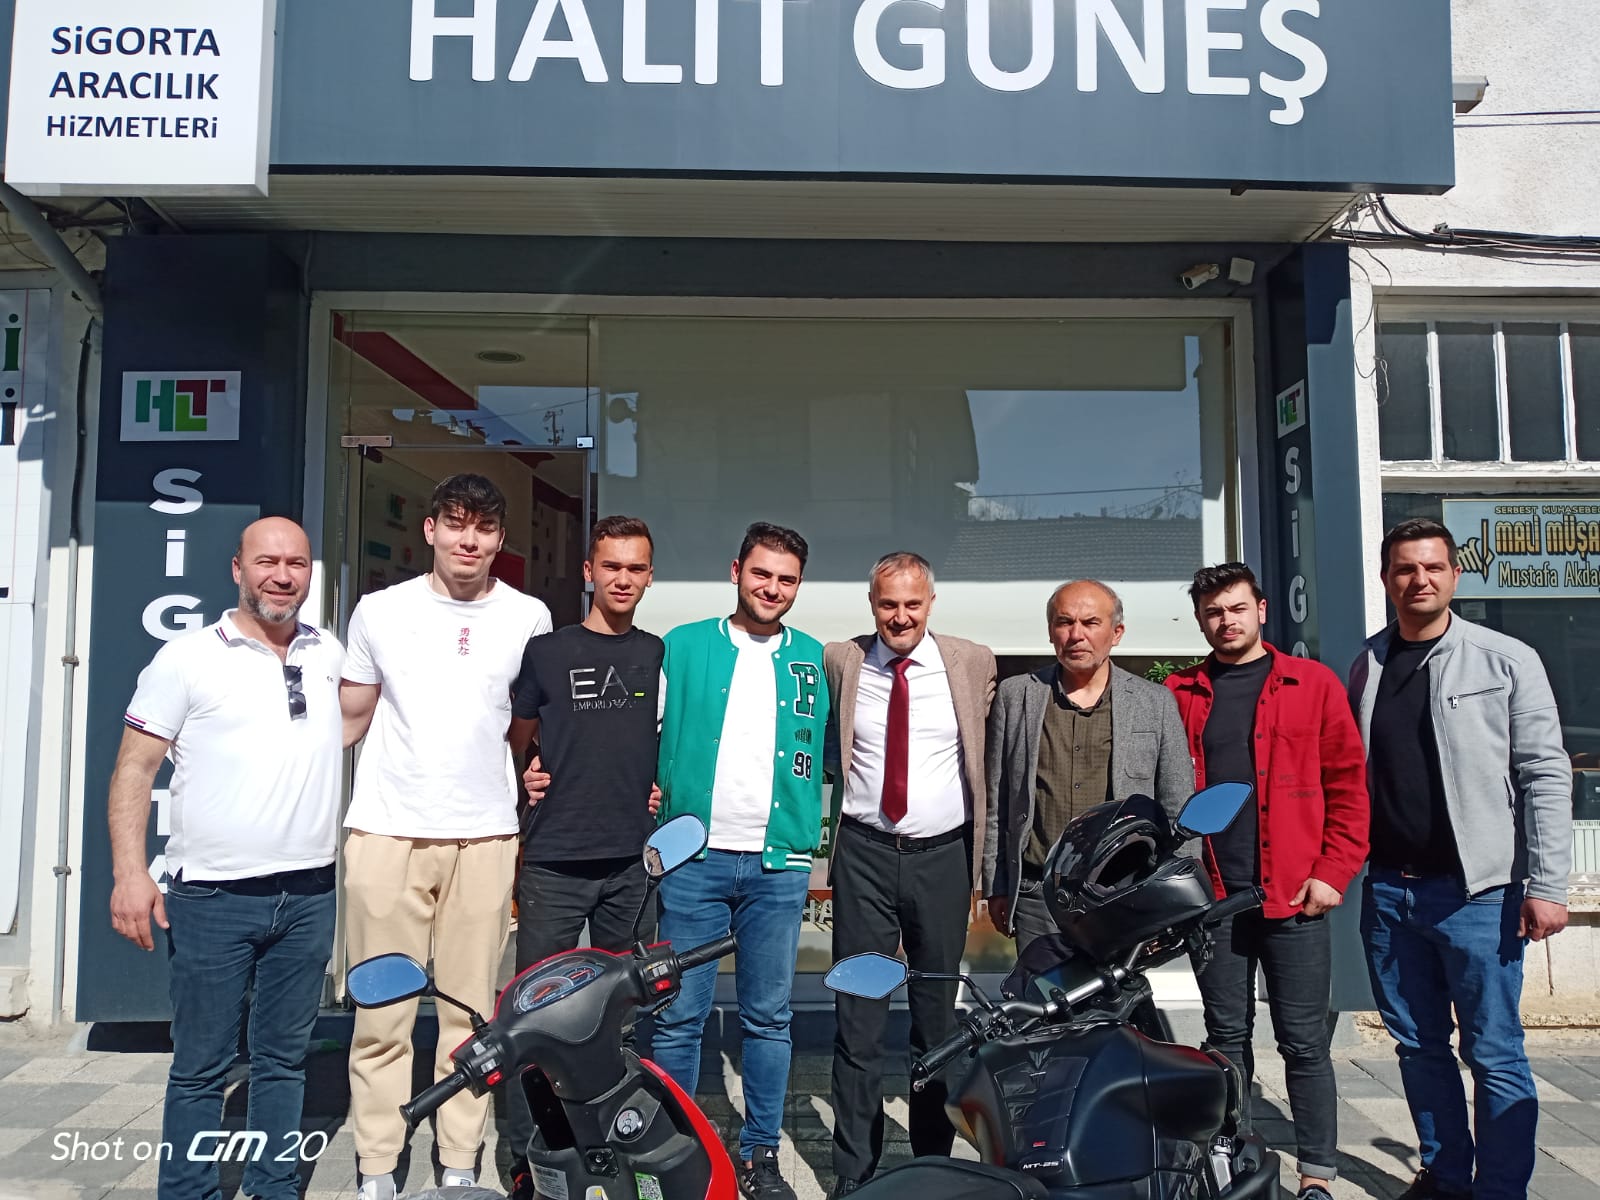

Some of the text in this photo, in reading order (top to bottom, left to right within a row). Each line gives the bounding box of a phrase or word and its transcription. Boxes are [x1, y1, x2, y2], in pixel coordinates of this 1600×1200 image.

[49, 71, 219, 100] ARACILIK
[1494, 505, 1538, 514] SERBEST
[1498, 561, 1600, 592] Mustafa Akda
[792, 750, 813, 781] 98
